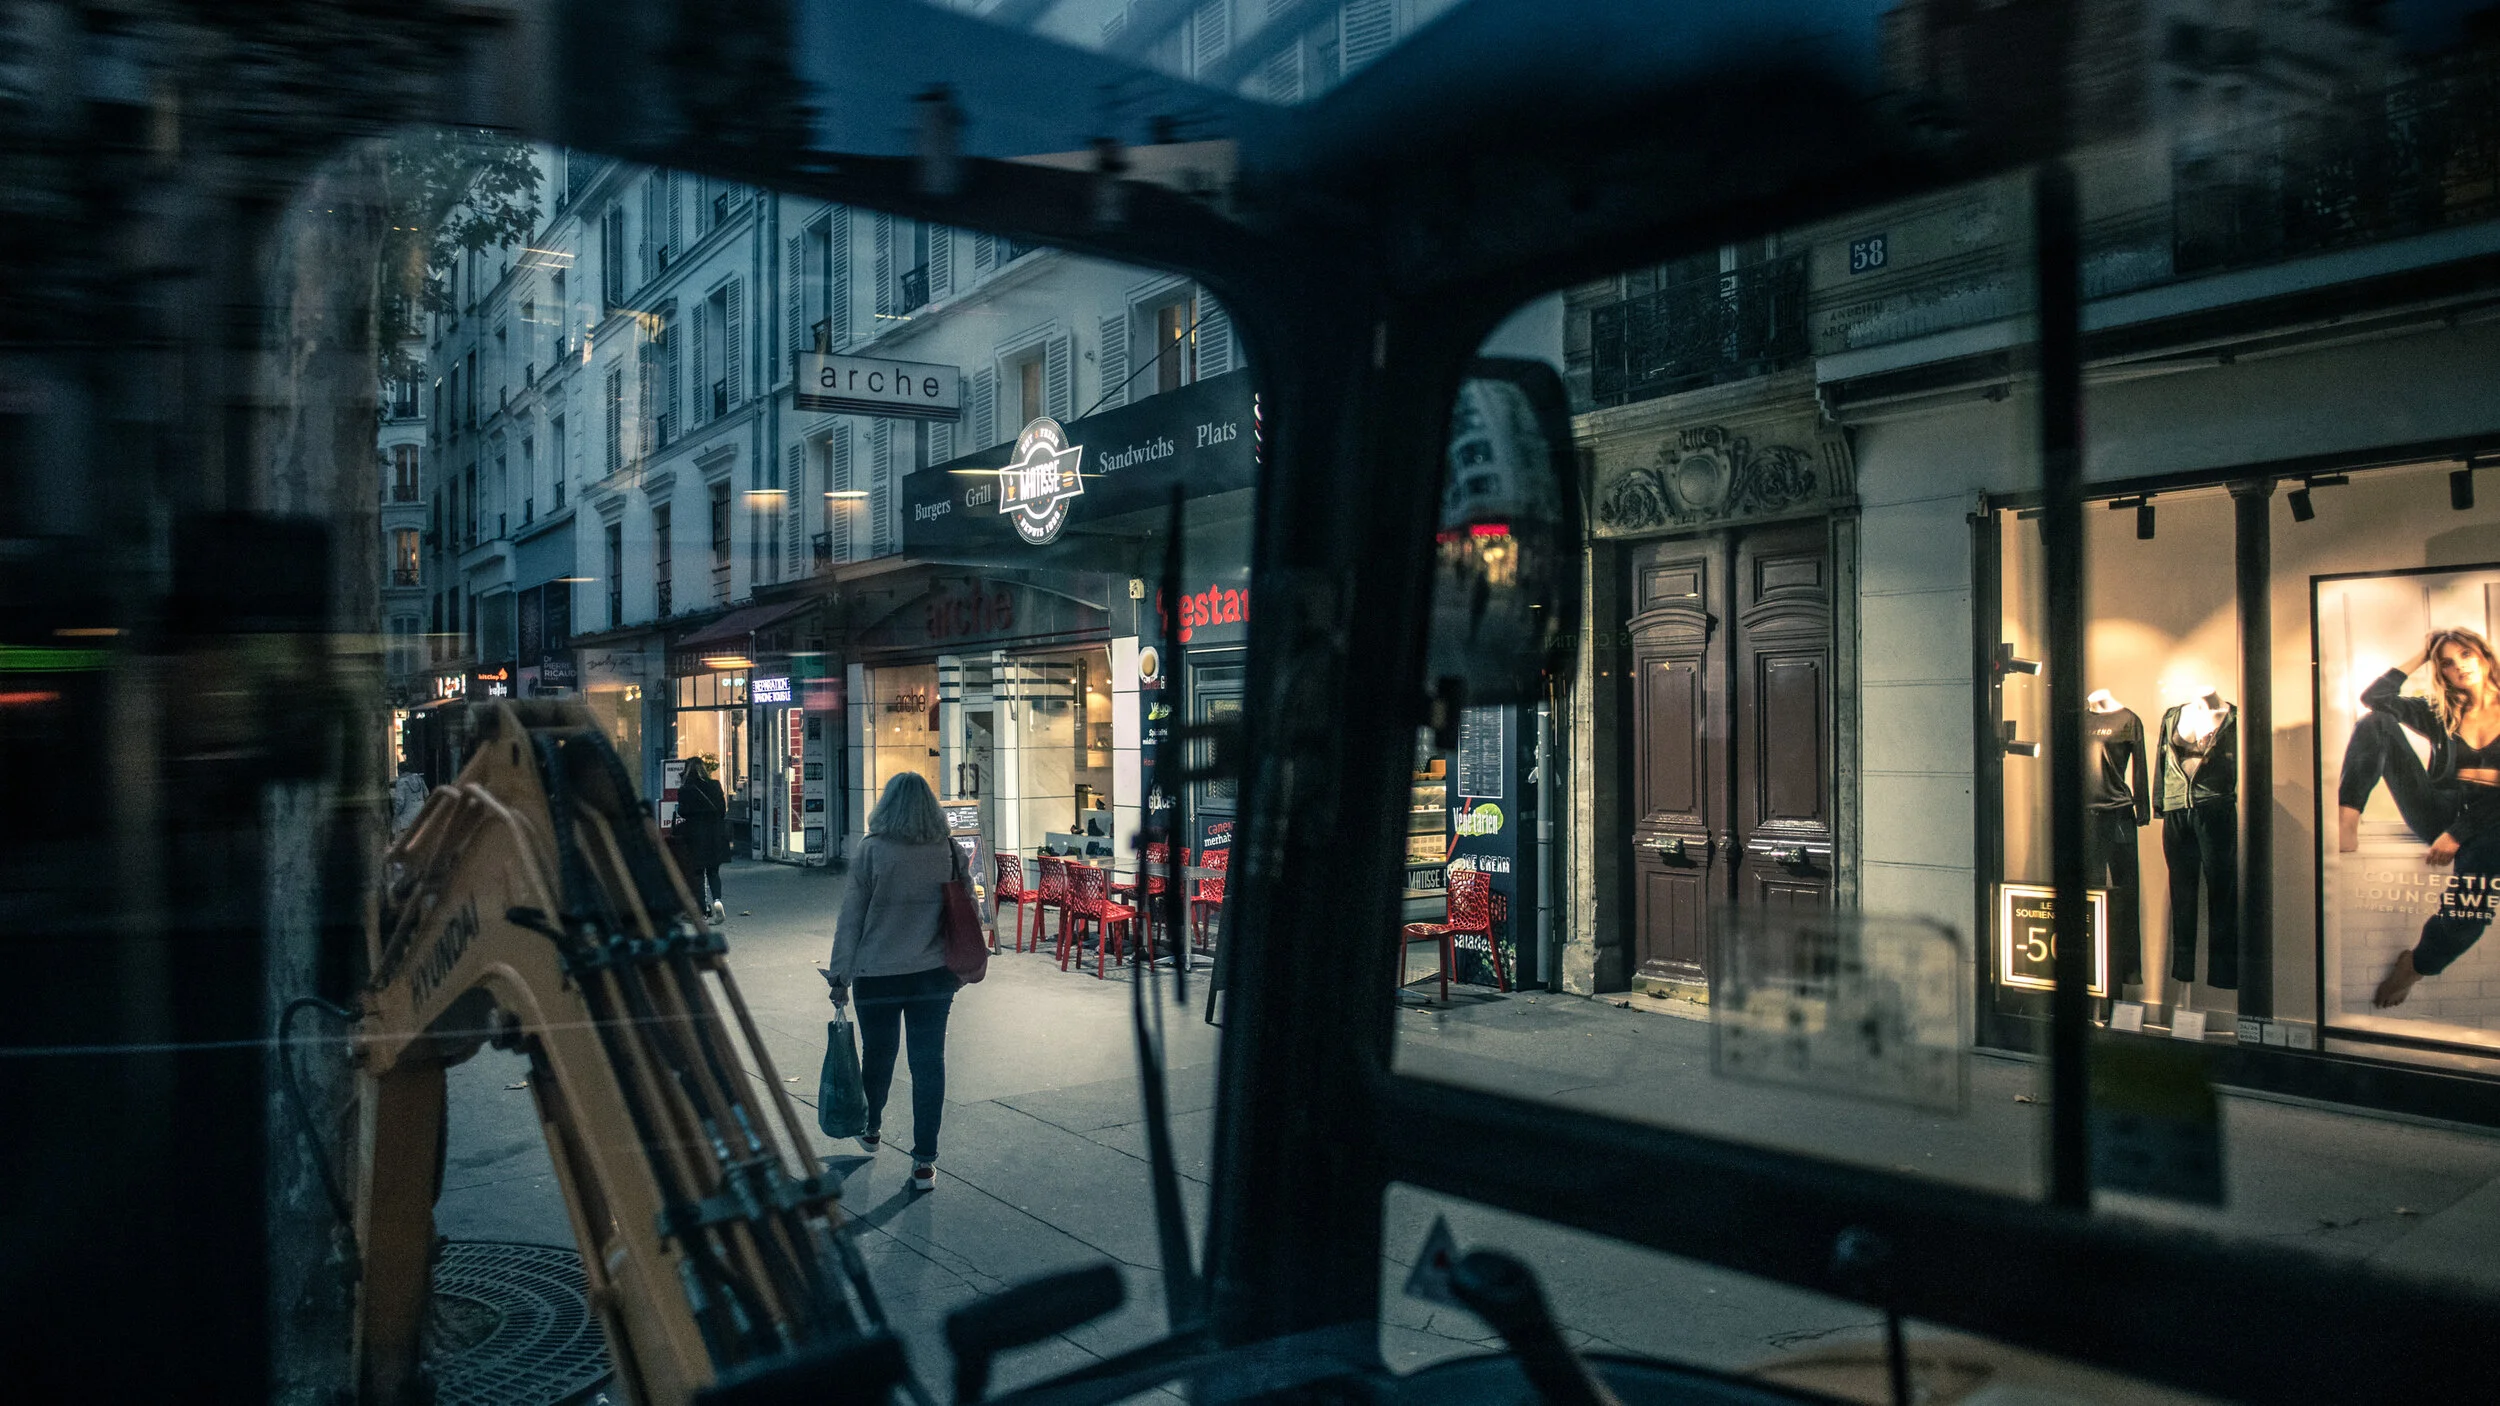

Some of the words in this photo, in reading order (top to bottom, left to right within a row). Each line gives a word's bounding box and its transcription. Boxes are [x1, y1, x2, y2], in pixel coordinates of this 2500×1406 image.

[1853, 239, 1884, 270] 58
[820, 366, 939, 398] arche
[1099, 436, 1175, 474] Sandwichs
[1196, 421, 1237, 449] Plats
[1020, 459, 1060, 501] MATISSE
[915, 499, 951, 521] Burgers
[965, 484, 992, 508] Grill
[1020, 517, 1044, 537] DEPUIS
[544, 669, 577, 677] RICAUD
[1461, 853, 1477, 870] ICE
[1479, 855, 1511, 874] CREAM
[1408, 868, 1440, 891] MATISSE
